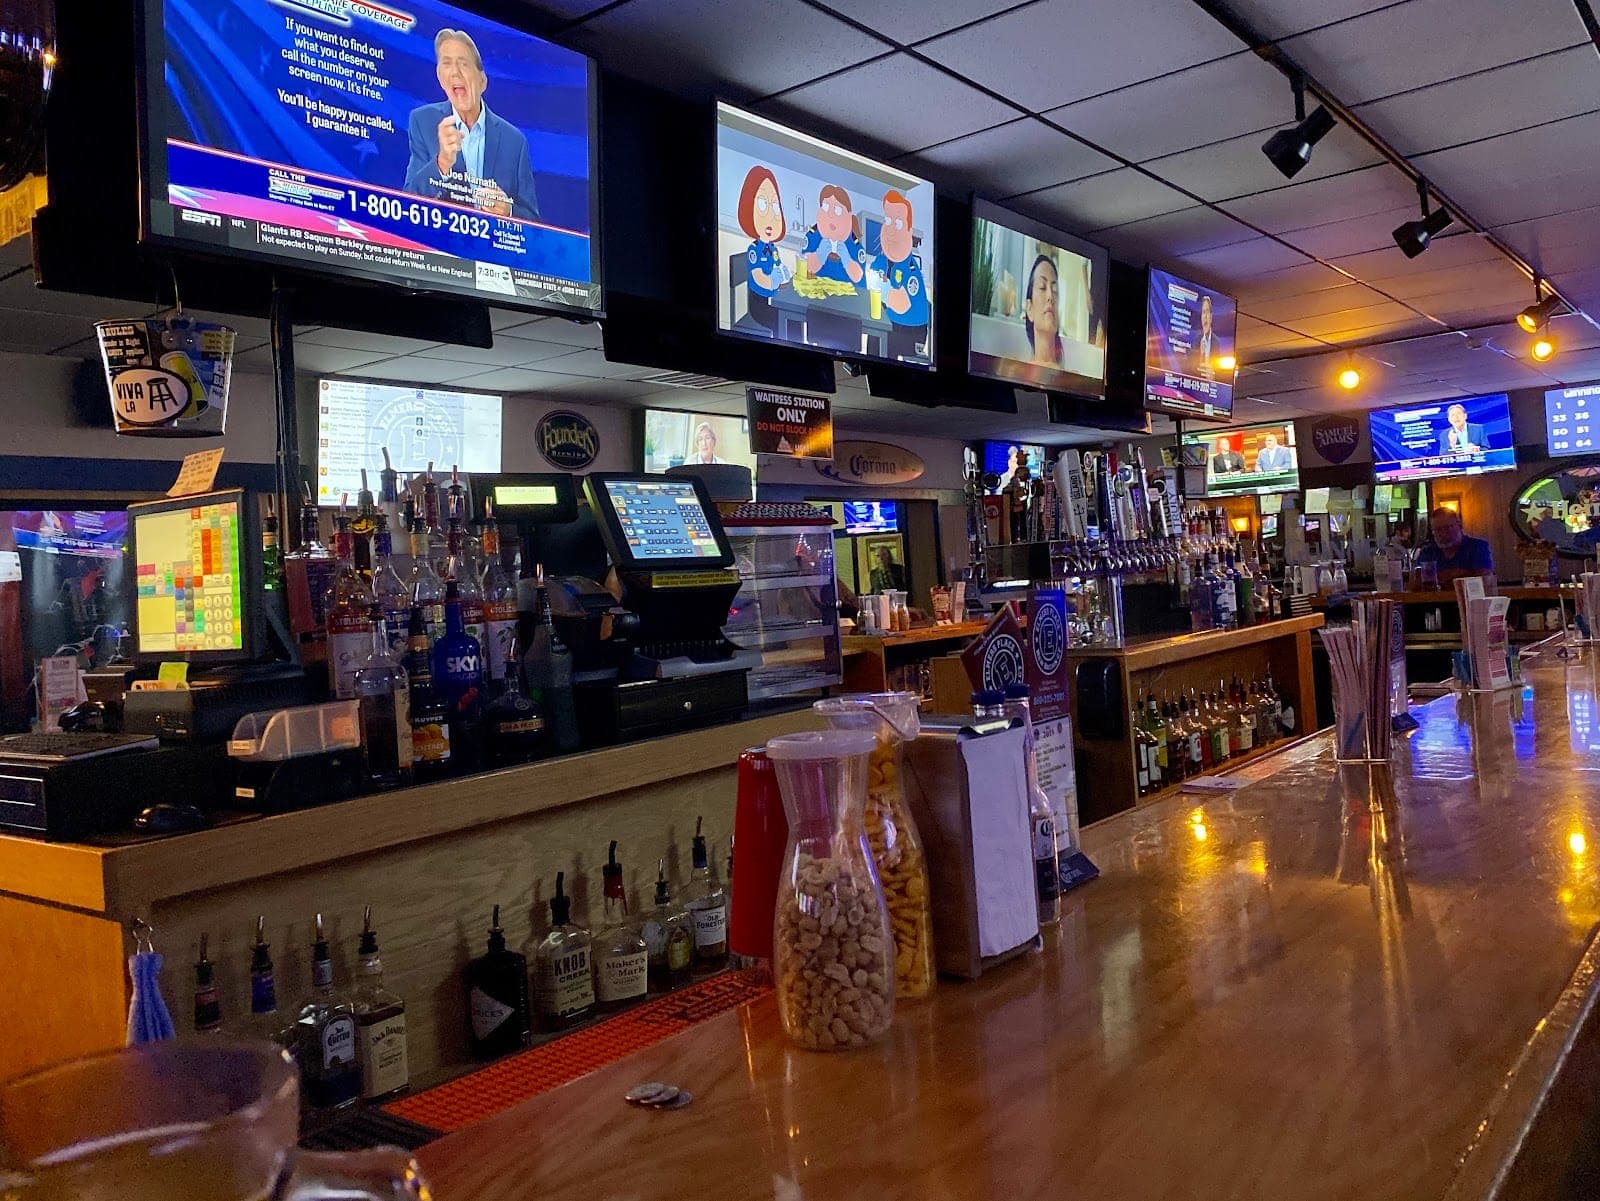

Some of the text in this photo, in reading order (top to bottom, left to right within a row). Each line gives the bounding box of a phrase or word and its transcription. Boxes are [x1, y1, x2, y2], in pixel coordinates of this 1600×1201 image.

[351, 2, 409, 30] COVERAGE
[285, 17, 385, 60] If you want to find out
[294, 37, 377, 73] what you deserve,
[281, 48, 389, 90] call the number on your
[288, 64, 384, 101] screen now. It's free.
[277, 88, 395, 134] You'll be happy you called,
[306, 111, 370, 139] I guarantee it.
[269, 168, 306, 183] CALL THE
[447, 168, 498, 189] Joe Namath
[181, 208, 222, 227] ESPN
[231, 218, 247, 228] NFL
[348, 189, 491, 240] 1-800-619-2032
[260, 223, 425, 261] Giants RB Saquon Barkley eyes early return
[260, 233, 275, 244] Not
[276, 238, 306, 251] expected
[306, 242, 314, 251] to
[314, 243, 329, 255] play
[329, 247, 338, 256] on
[338, 248, 363, 261] Sunday,
[363, 252, 374, 261] but
[375, 255, 393, 265] could
[392, 257, 411, 269] return
[410, 260, 426, 271] Week
[431, 265, 438, 273] at
[438, 266, 450, 275] New
[450, 267, 473, 279] England
[115, 382, 145, 401] VIVA
[754, 391, 825, 410] WAITRESS STATION
[124, 401, 137, 413] LA
[776, 407, 807, 424] ONLY
[1556, 401, 1562, 410] 1
[756, 421, 769, 431] DO
[769, 422, 785, 433] NOT
[543, 422, 595, 459] Founders
[850, 454, 897, 478] Corona
[1167, 491, 1181, 530] TRULY
[554, 951, 586, 977] KNOB
[559, 968, 590, 983] CREEK
[618, 966, 645, 978] Mark
